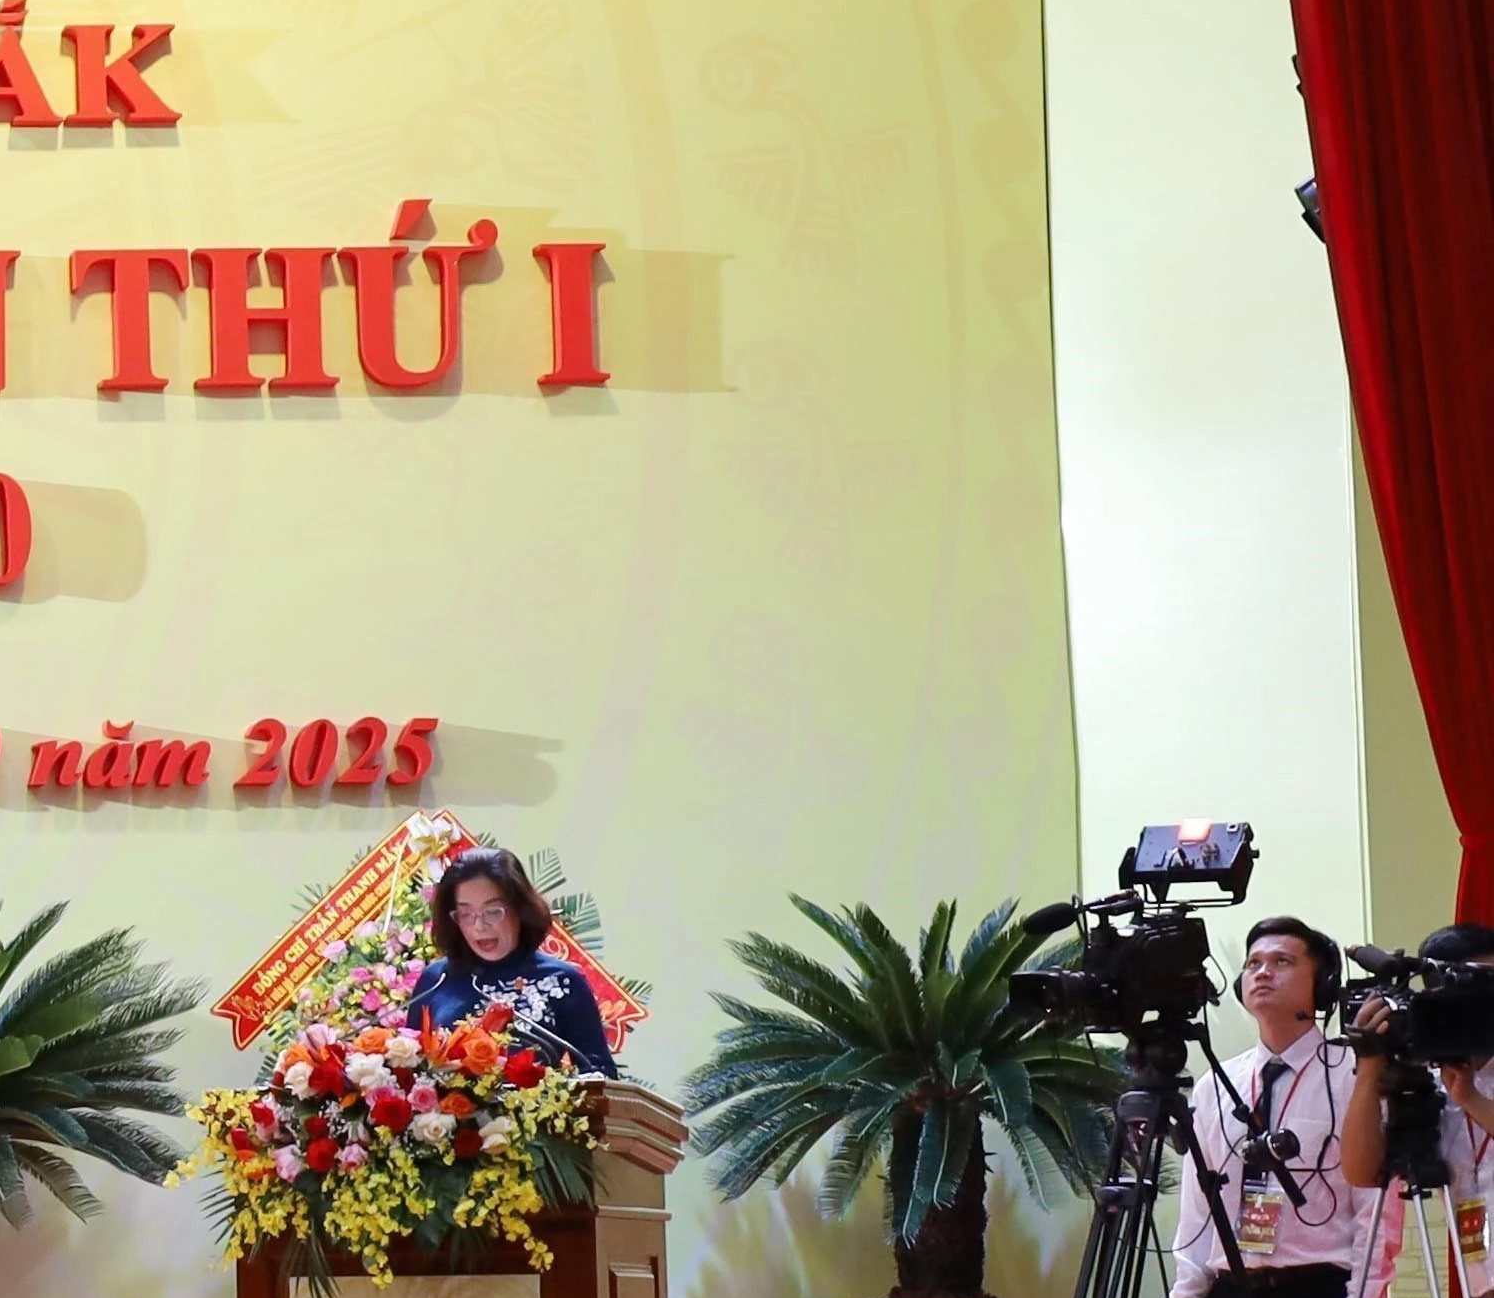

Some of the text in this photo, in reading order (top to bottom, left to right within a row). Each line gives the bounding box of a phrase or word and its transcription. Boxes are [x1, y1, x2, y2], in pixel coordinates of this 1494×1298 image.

[73, 200, 497, 396] THỨ
[535, 244, 610, 388] I
[28, 722, 210, 794] năm
[238, 717, 437, 793] 2025
[252, 959, 287, 996] ĐỒNG
[284, 935, 308, 962] CHÍ
[335, 867, 378, 911] THANH
